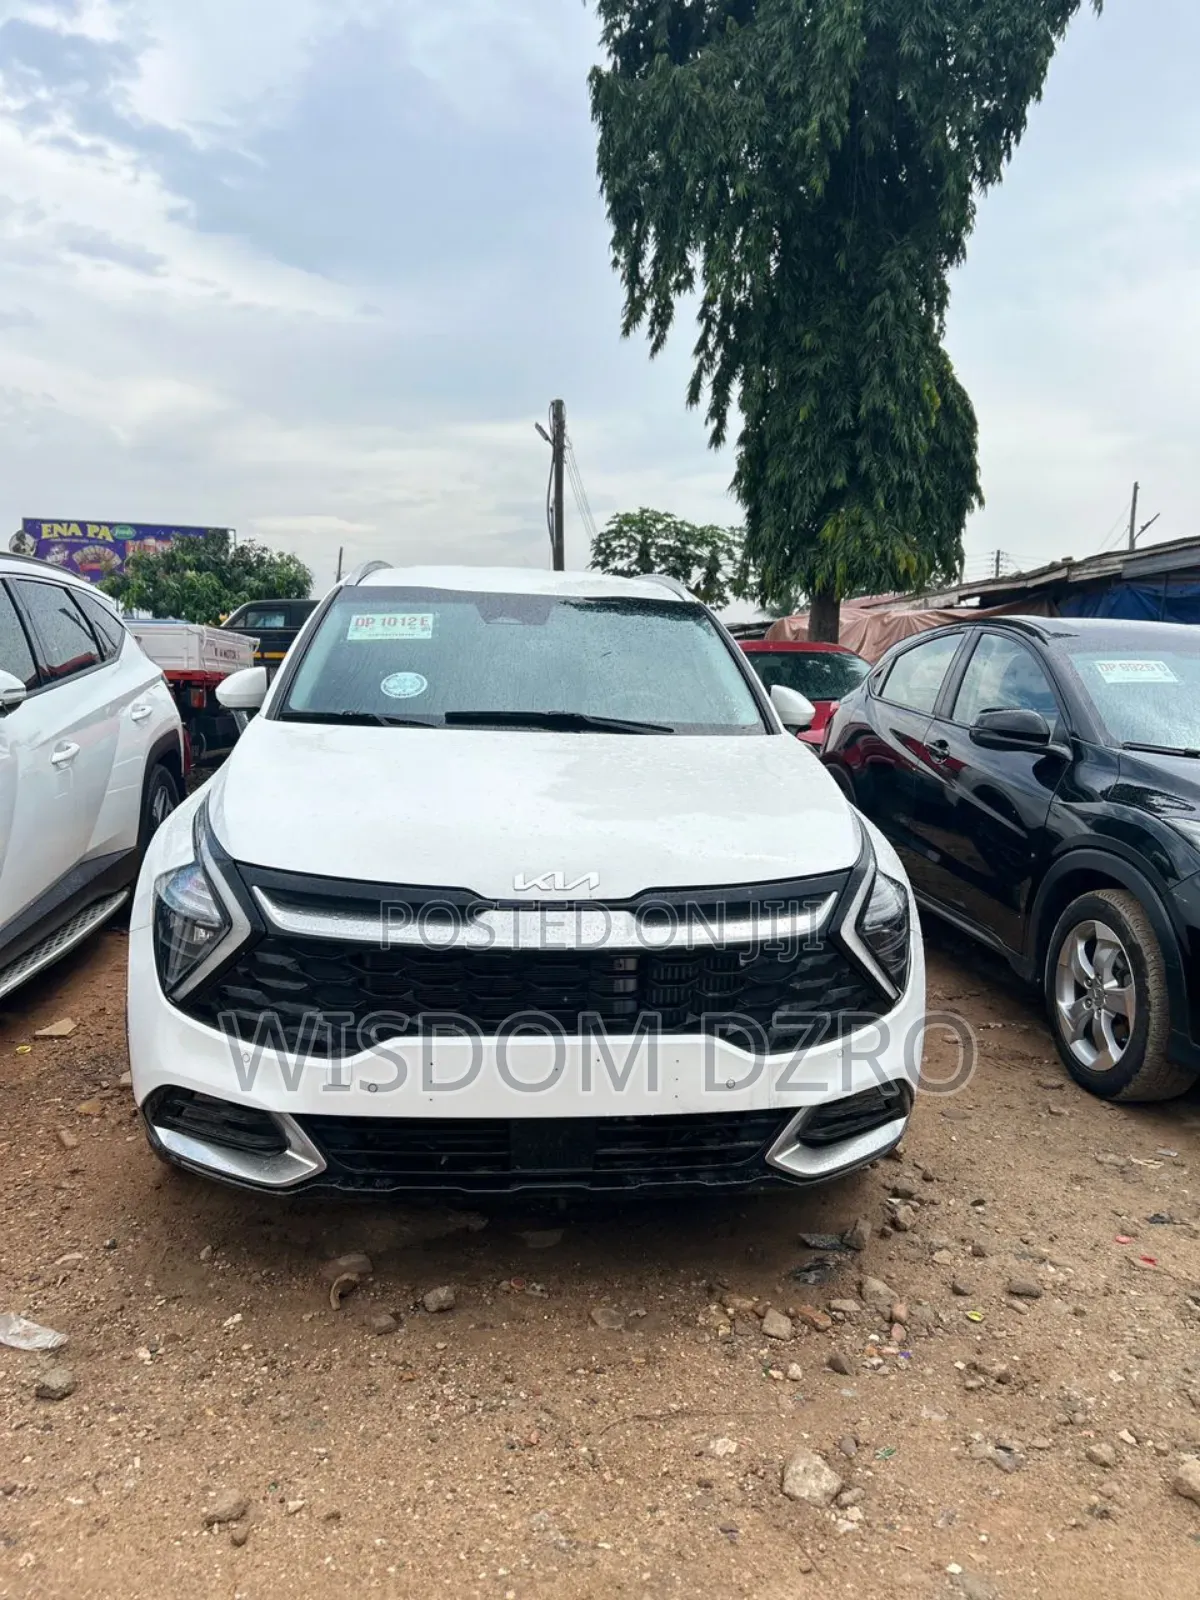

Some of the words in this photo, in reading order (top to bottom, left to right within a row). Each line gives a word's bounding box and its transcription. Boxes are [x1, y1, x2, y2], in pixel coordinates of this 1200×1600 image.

[41, 523, 83, 539] ENA
[86, 524, 114, 543] PA
[380, 616, 417, 627] 1012
[513, 871, 600, 891] KIA
